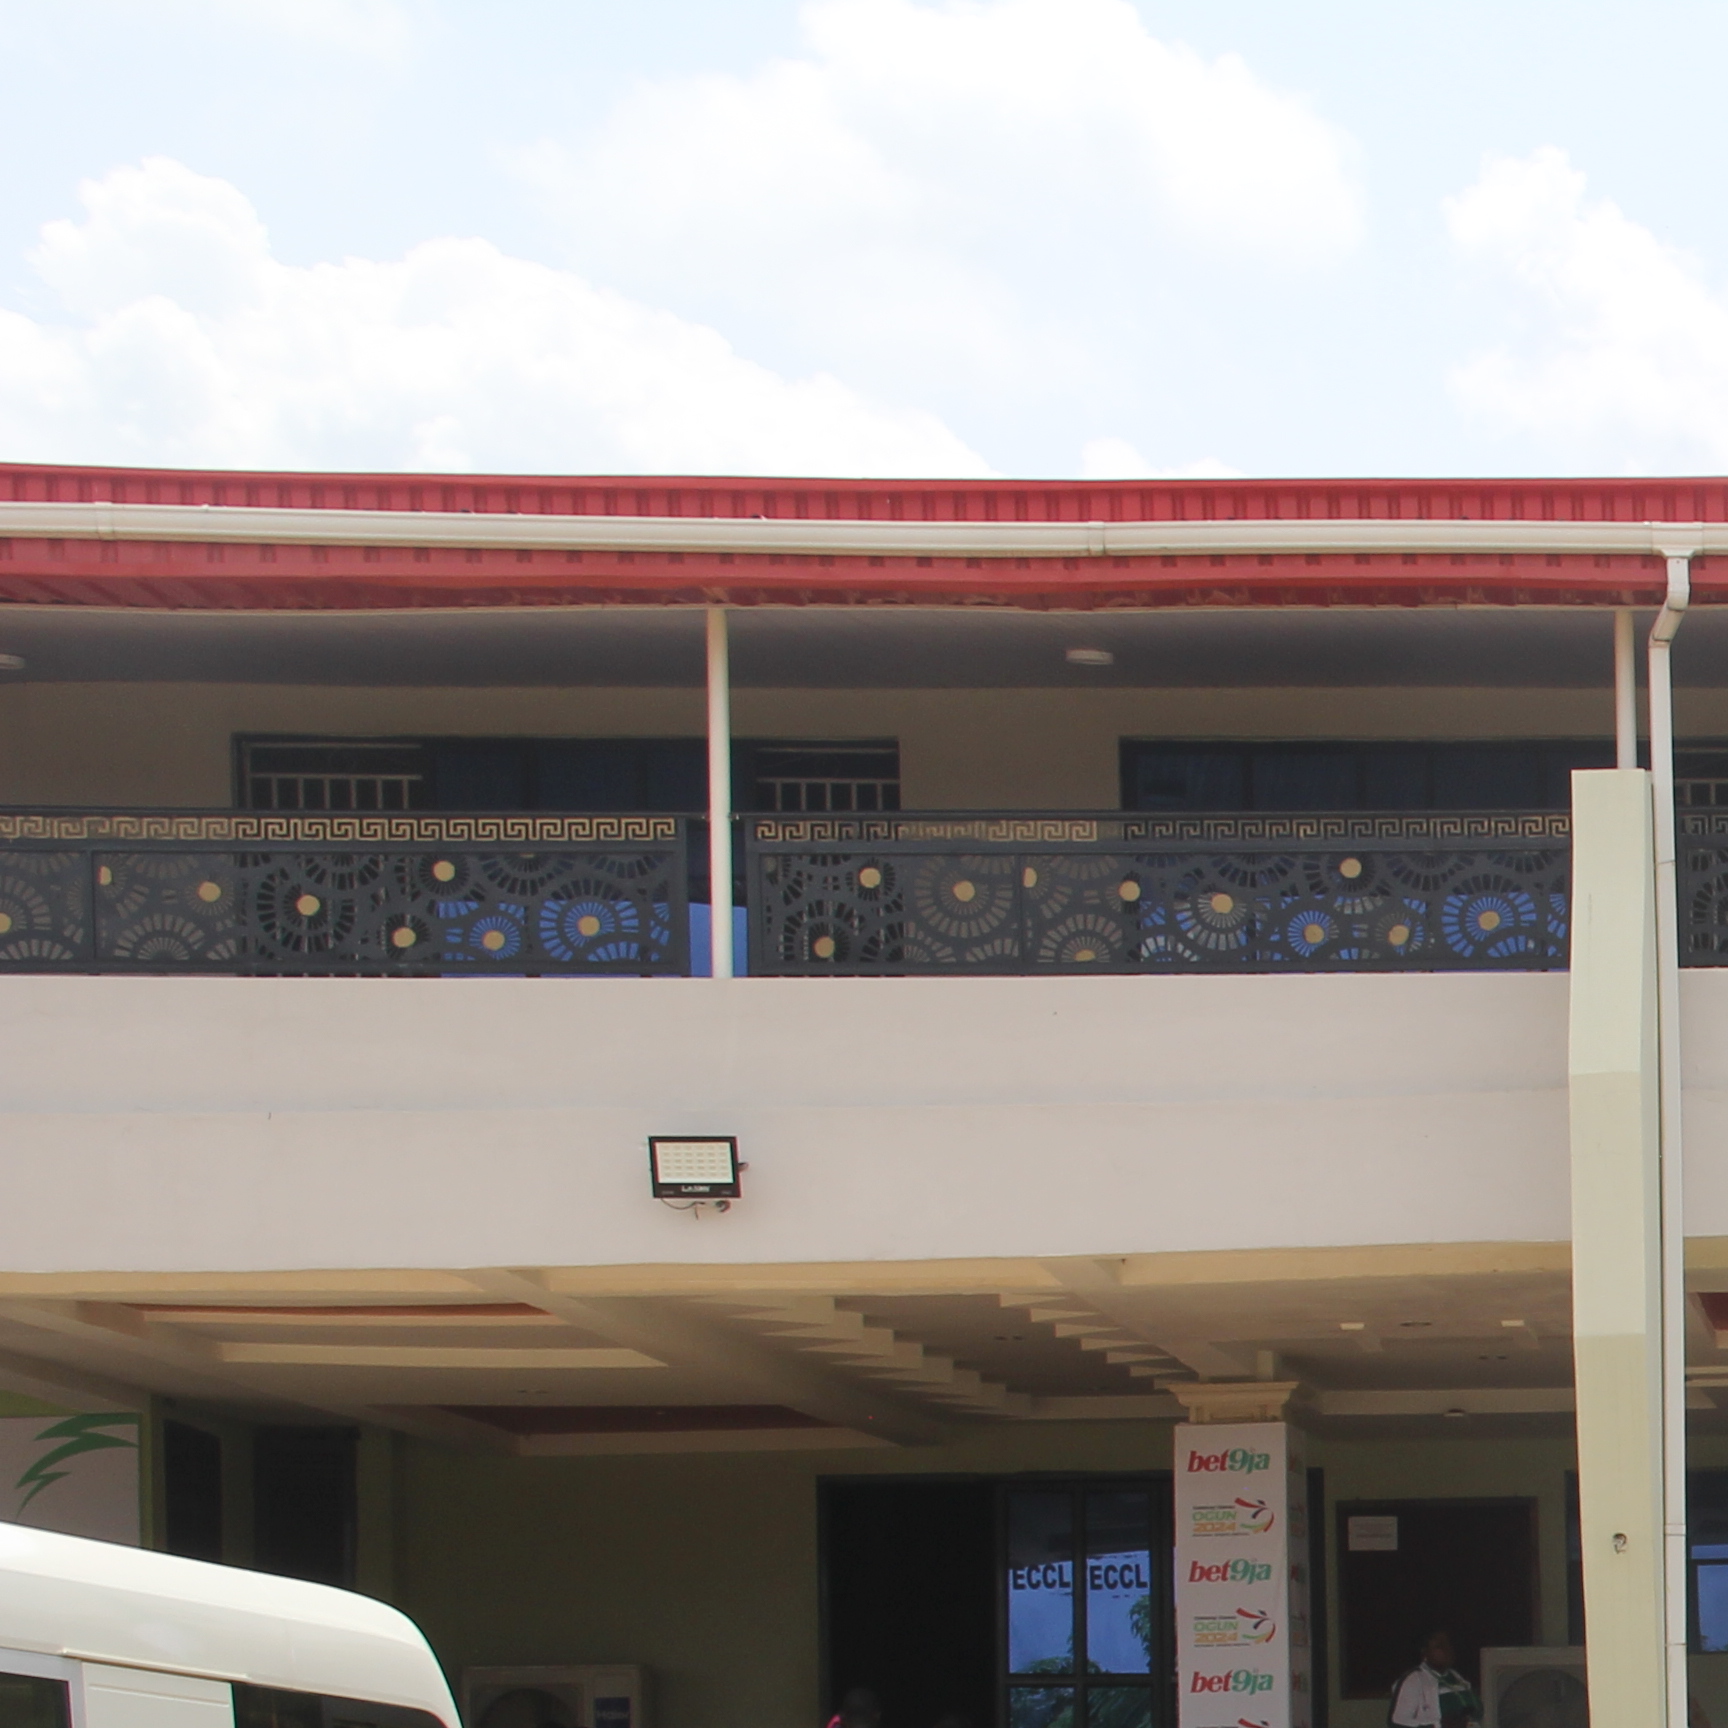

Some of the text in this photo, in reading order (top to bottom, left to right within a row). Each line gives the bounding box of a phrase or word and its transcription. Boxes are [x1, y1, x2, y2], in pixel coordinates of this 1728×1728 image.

[1187, 1446, 1271, 1474] bet9ja
[1192, 1522, 1237, 1533] 2024
[1012, 1563, 1149, 1590] ECCL ECCL
[1188, 1557, 1272, 1585] bet9ja
[1194, 1632, 1238, 1643] 2024
[1190, 1669, 1274, 1696] bet9ja
